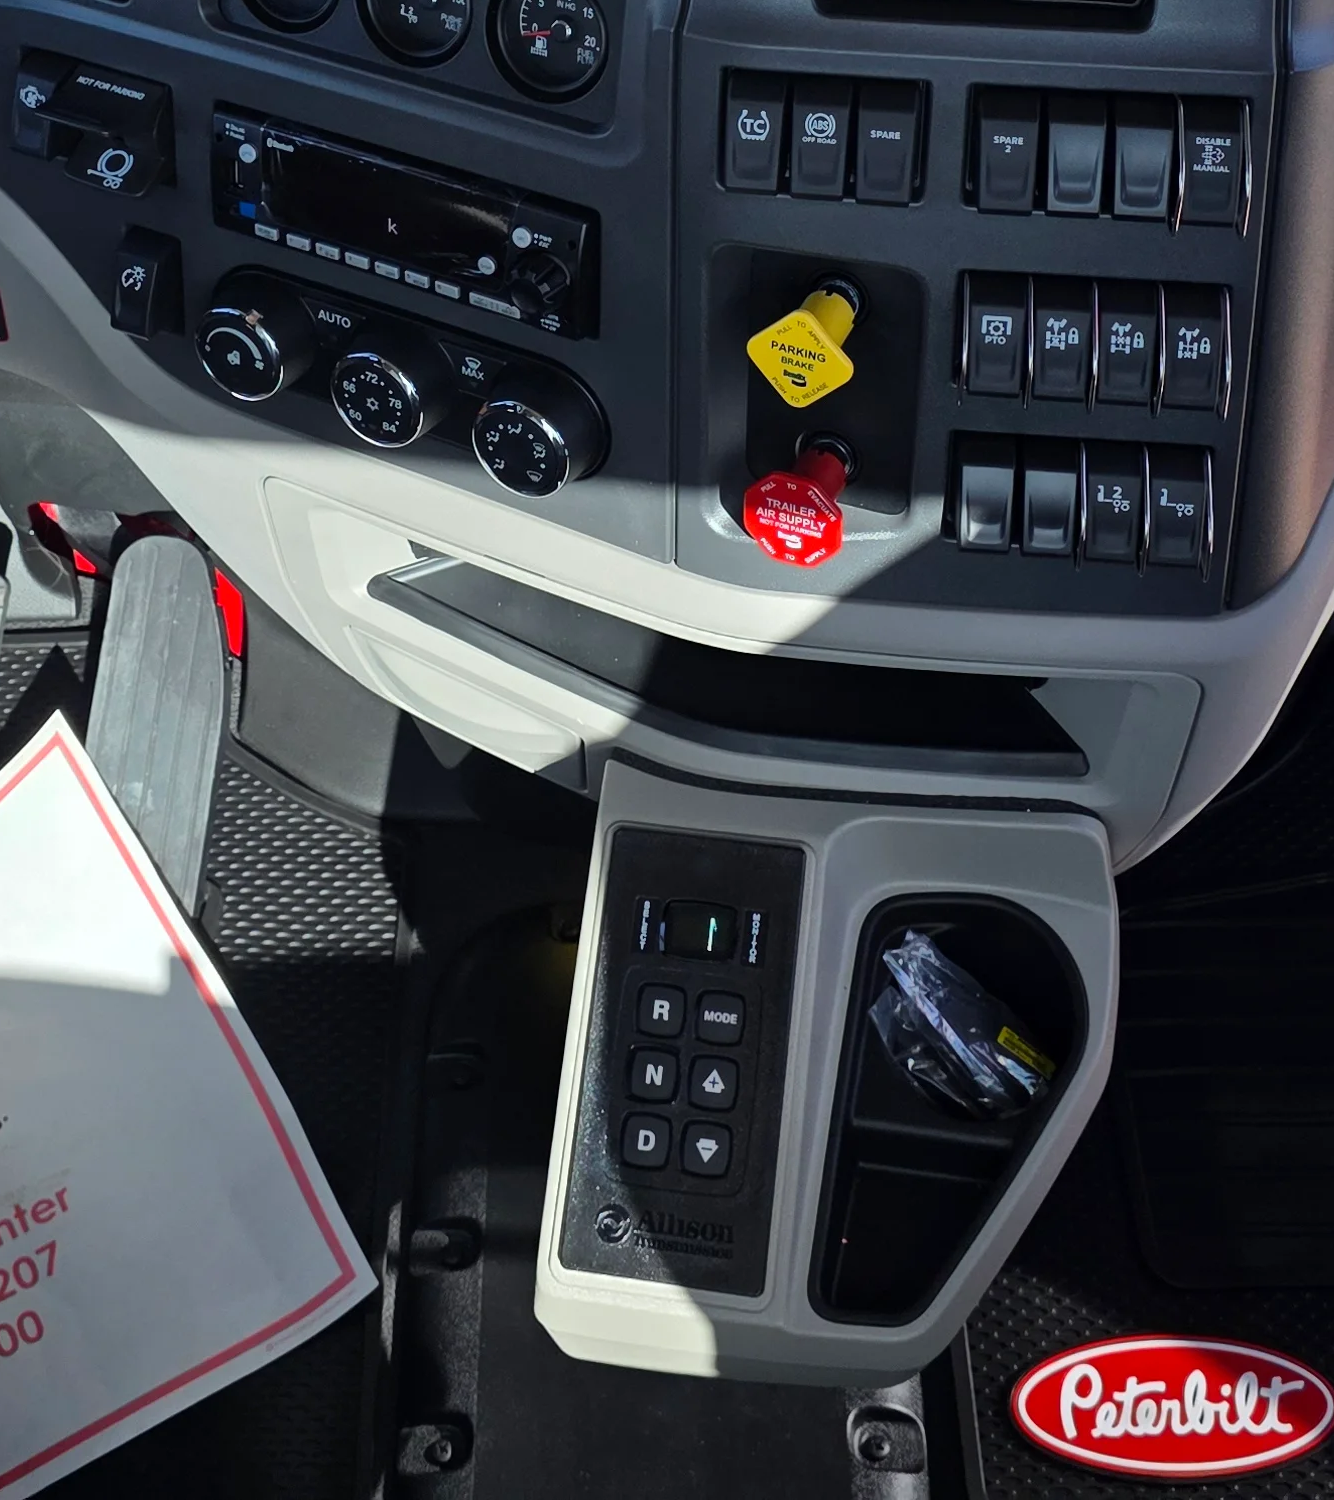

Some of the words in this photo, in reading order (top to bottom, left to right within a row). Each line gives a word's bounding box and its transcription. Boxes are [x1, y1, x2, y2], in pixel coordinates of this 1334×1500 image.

[582, 7, 594, 19] 15
[584, 35, 597, 48] 20
[76, 75, 93, 86] NOT
[93, 80, 111, 91] FOR
[110, 85, 146, 101] PARKING
[743, 118, 766, 134] TC
[811, 119, 829, 132] ABS
[802, 136, 815, 144] OFF
[817, 137, 837, 146] ROAD
[870, 129, 901, 140] SPARE
[993, 135, 1024, 146] SPARE
[1195, 136, 1232, 147] DISABLE
[1192, 163, 1230, 174] MANUAL
[387, 217, 399, 236] k
[317, 309, 352, 329] AUTO
[776, 324, 793, 336] PULL
[796, 320, 807, 329] TO
[807, 329, 826, 350] APPLY
[984, 334, 1007, 345] PTO
[770, 340, 827, 363] PARKING
[780, 355, 815, 372] BRAKE
[364, 371, 379, 385] 72
[461, 365, 486, 382] MAX
[342, 380, 357, 394] 66
[771, 376, 787, 394] PUSH
[790, 395, 800, 404] TO
[801, 382, 829, 400] RELEASE
[388, 397, 403, 410] 78
[348, 409, 363, 422] 60
[382, 421, 397, 434] 84
[1112, 486, 1123, 499] 2
[760, 481, 777, 493] PULL
[786, 482, 797, 491] TO
[807, 490, 837, 522] EVACUATE
[766, 497, 817, 519] TRAILER
[755, 506, 776, 520] AIR
[778, 512, 827, 532] SUPPLY
[759, 517, 775, 526] NOT
[774, 521, 790, 531] FOR
[790, 525, 822, 539] PARKING
[760, 537, 776, 555] PUSH
[784, 552, 796, 561] TO
[804, 547, 826, 564] SUPPLY
[639, 900, 651, 950] SELECT
[748, 912, 762, 964] MONITOR
[652, 999, 671, 1021] R
[703, 1010, 739, 1025] MODE
[645, 1063, 664, 1086] N
[637, 1129, 656, 1152] D
[638, 1209, 734, 1244] Allison
[1059, 1362, 1305, 1440] Peterbilt
